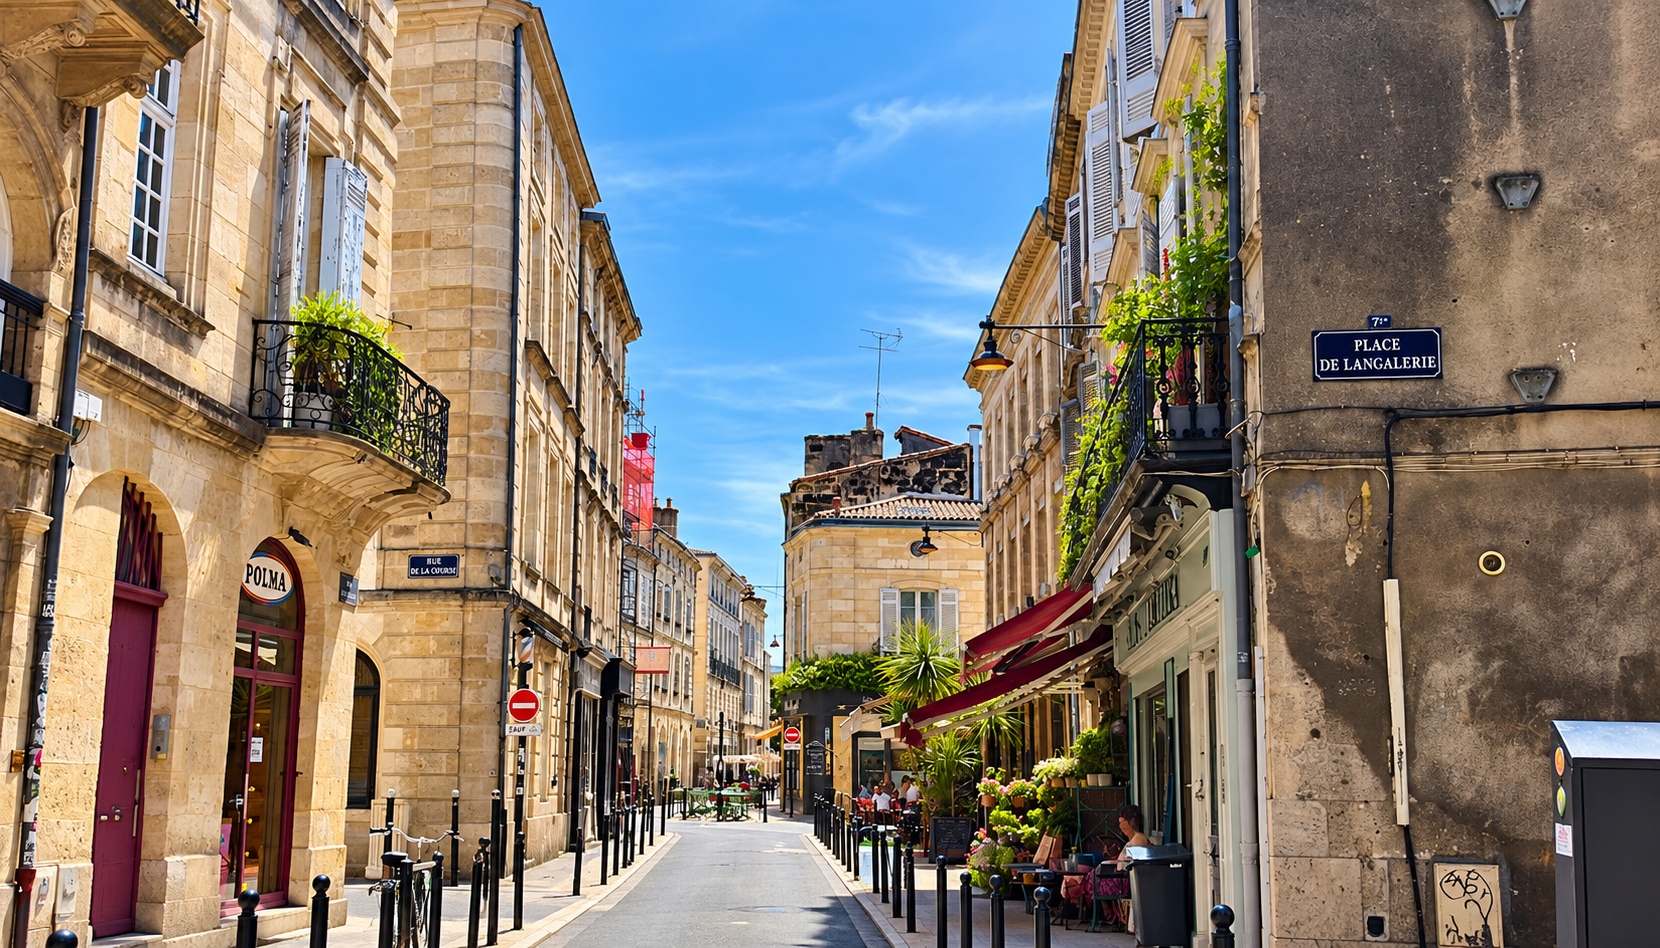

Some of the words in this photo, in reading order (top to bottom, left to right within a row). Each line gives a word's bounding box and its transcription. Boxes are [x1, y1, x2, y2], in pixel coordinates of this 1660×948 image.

[1354, 338, 1400, 351] PLACE
[1320, 359, 1339, 371] DE
[1344, 356, 1436, 370] LANGALERIE
[245, 563, 286, 592] POLMA
